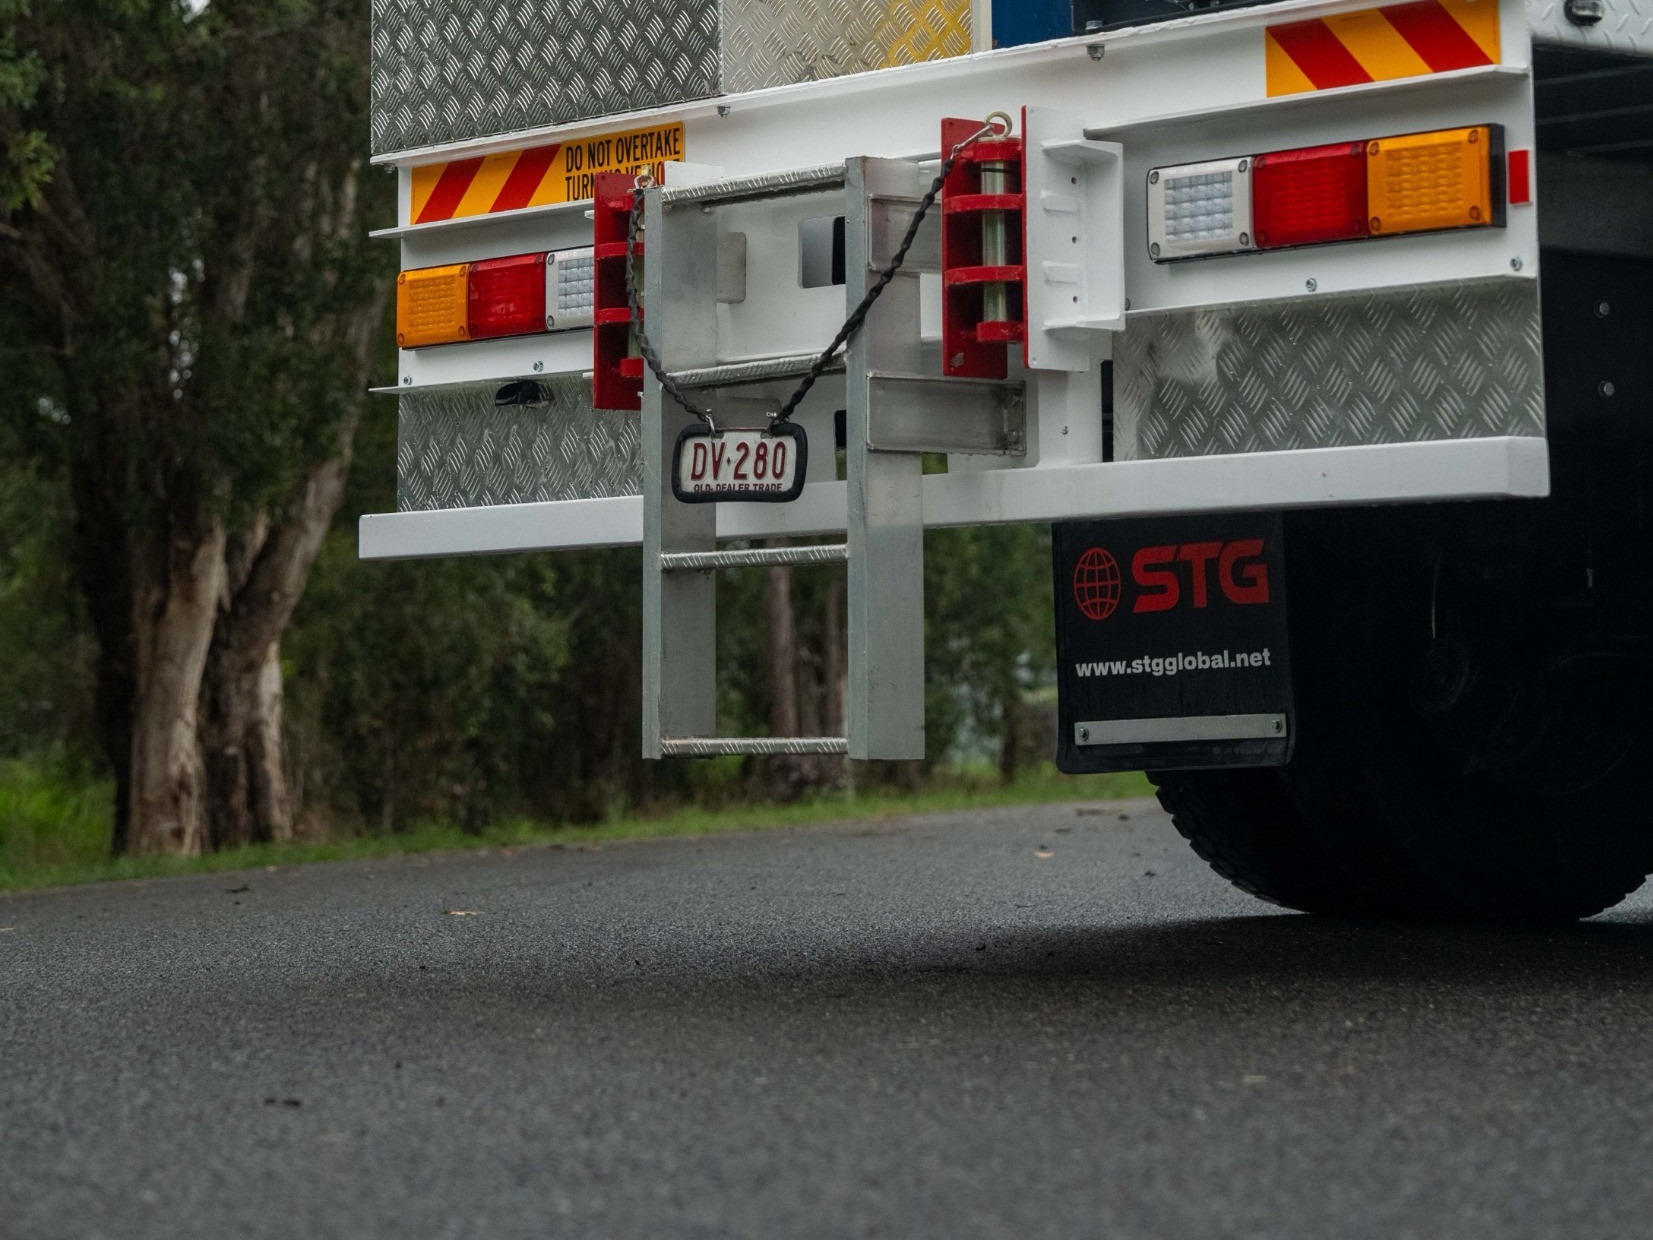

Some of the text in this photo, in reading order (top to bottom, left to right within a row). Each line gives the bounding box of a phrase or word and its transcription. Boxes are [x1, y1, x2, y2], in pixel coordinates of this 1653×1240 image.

[565, 127, 681, 173] DO NOT OVERTAKE
[1131, 538, 1270, 614] STG
[1075, 648, 1271, 677] www.stgglobal.net
